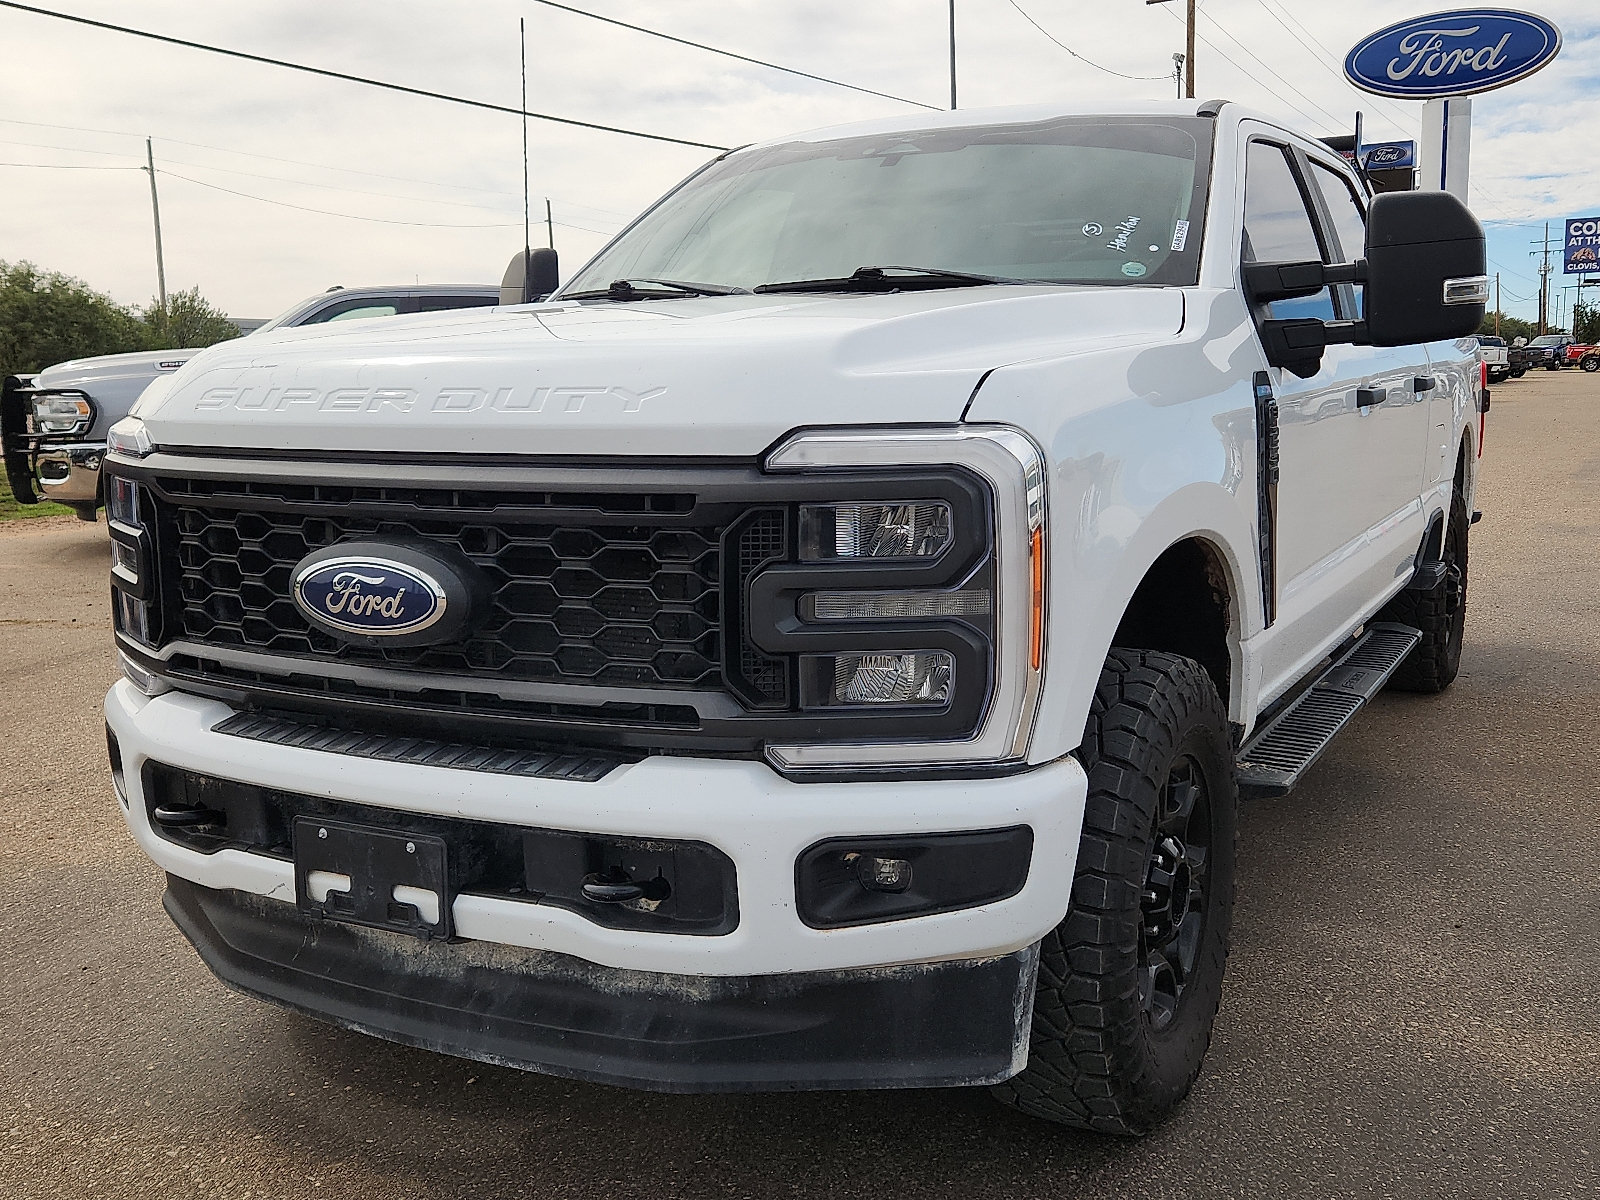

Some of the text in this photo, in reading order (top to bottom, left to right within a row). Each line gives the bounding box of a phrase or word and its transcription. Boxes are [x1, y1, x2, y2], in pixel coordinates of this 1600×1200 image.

[1386, 25, 1513, 81] Ford
[1374, 148, 1399, 162] Ford
[1570, 221, 1600, 236] CO
[1568, 237, 1584, 247] AT
[1567, 262, 1600, 270] CLOVIS,
[194, 386, 668, 413] SUPER DUTY
[325, 571, 406, 619] Ford
